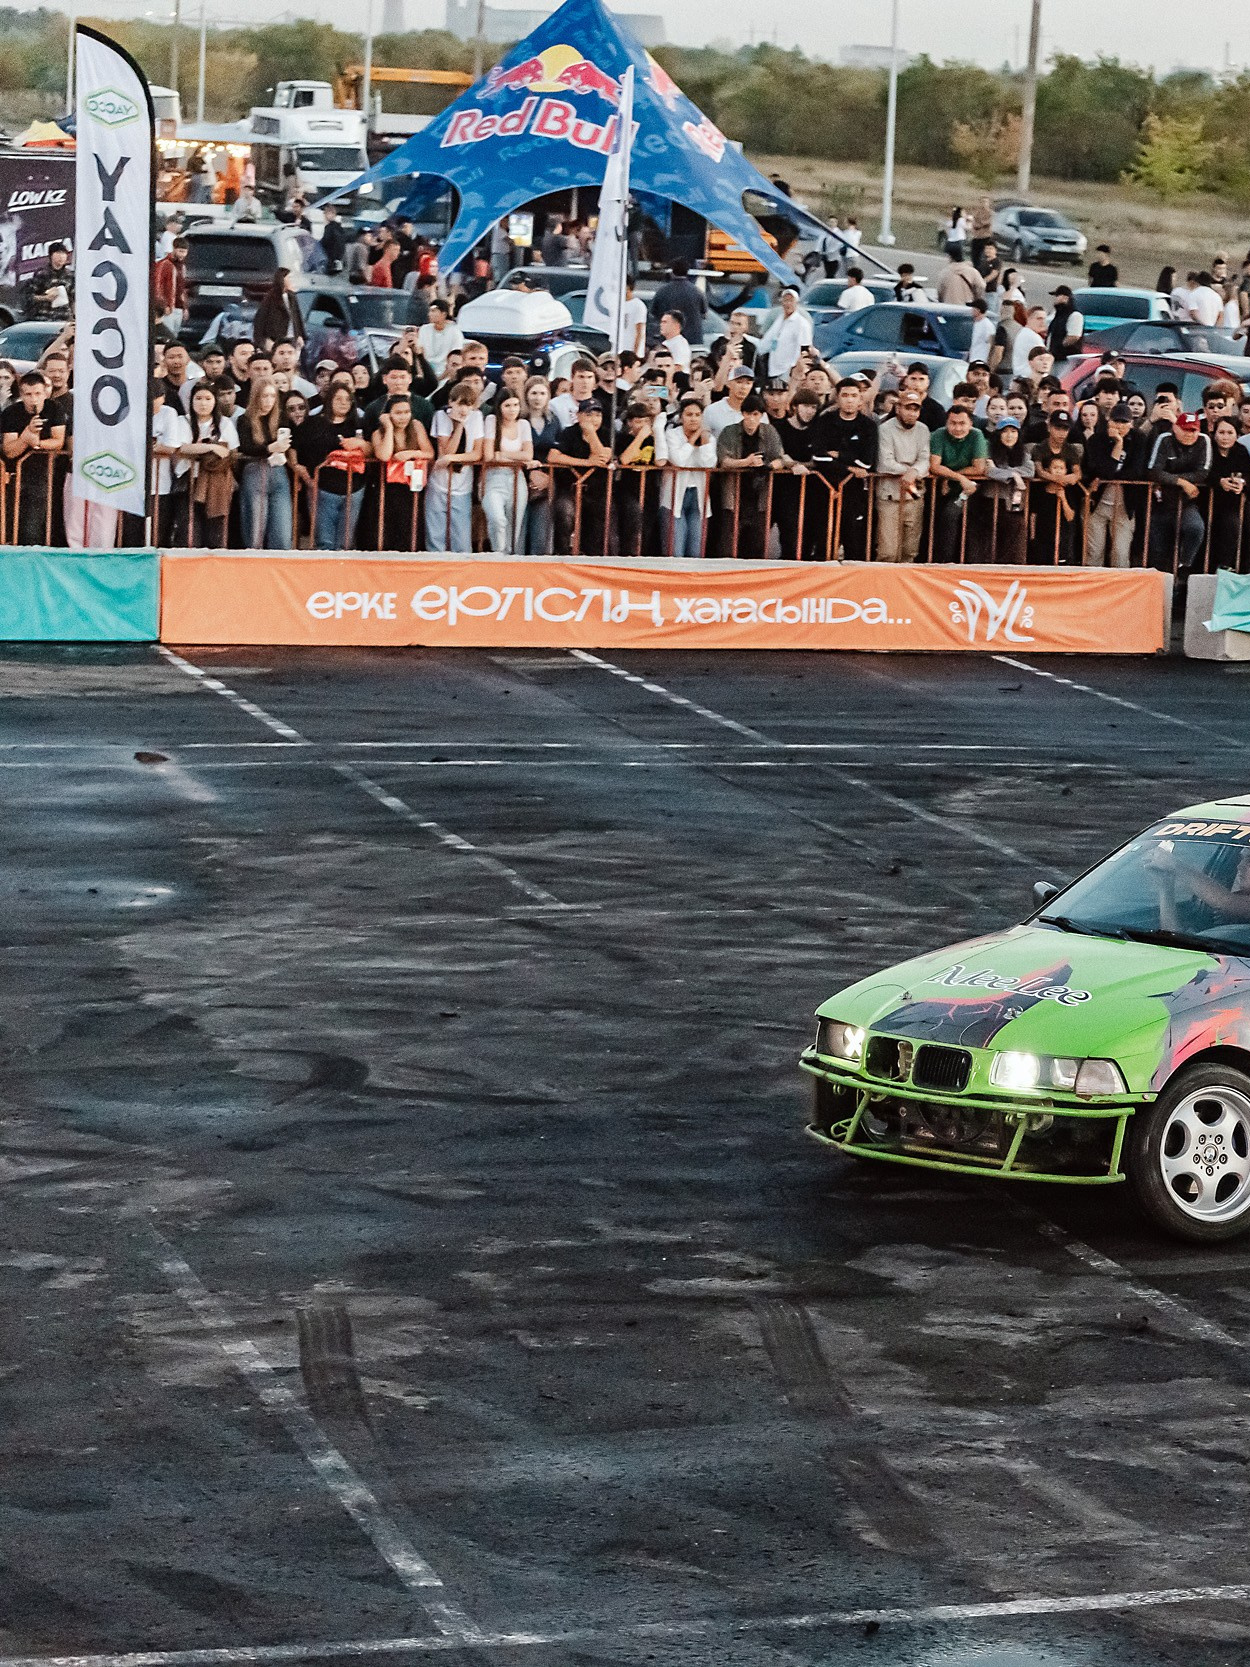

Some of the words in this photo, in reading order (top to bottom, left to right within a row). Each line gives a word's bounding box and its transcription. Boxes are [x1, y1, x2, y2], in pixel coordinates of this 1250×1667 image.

[441, 97, 540, 147] Red
[530, 99, 638, 155] Bul
[7, 190, 45, 207] LOW
[44, 189, 67, 203] KZ
[923, 964, 1093, 1007] MeeLee
